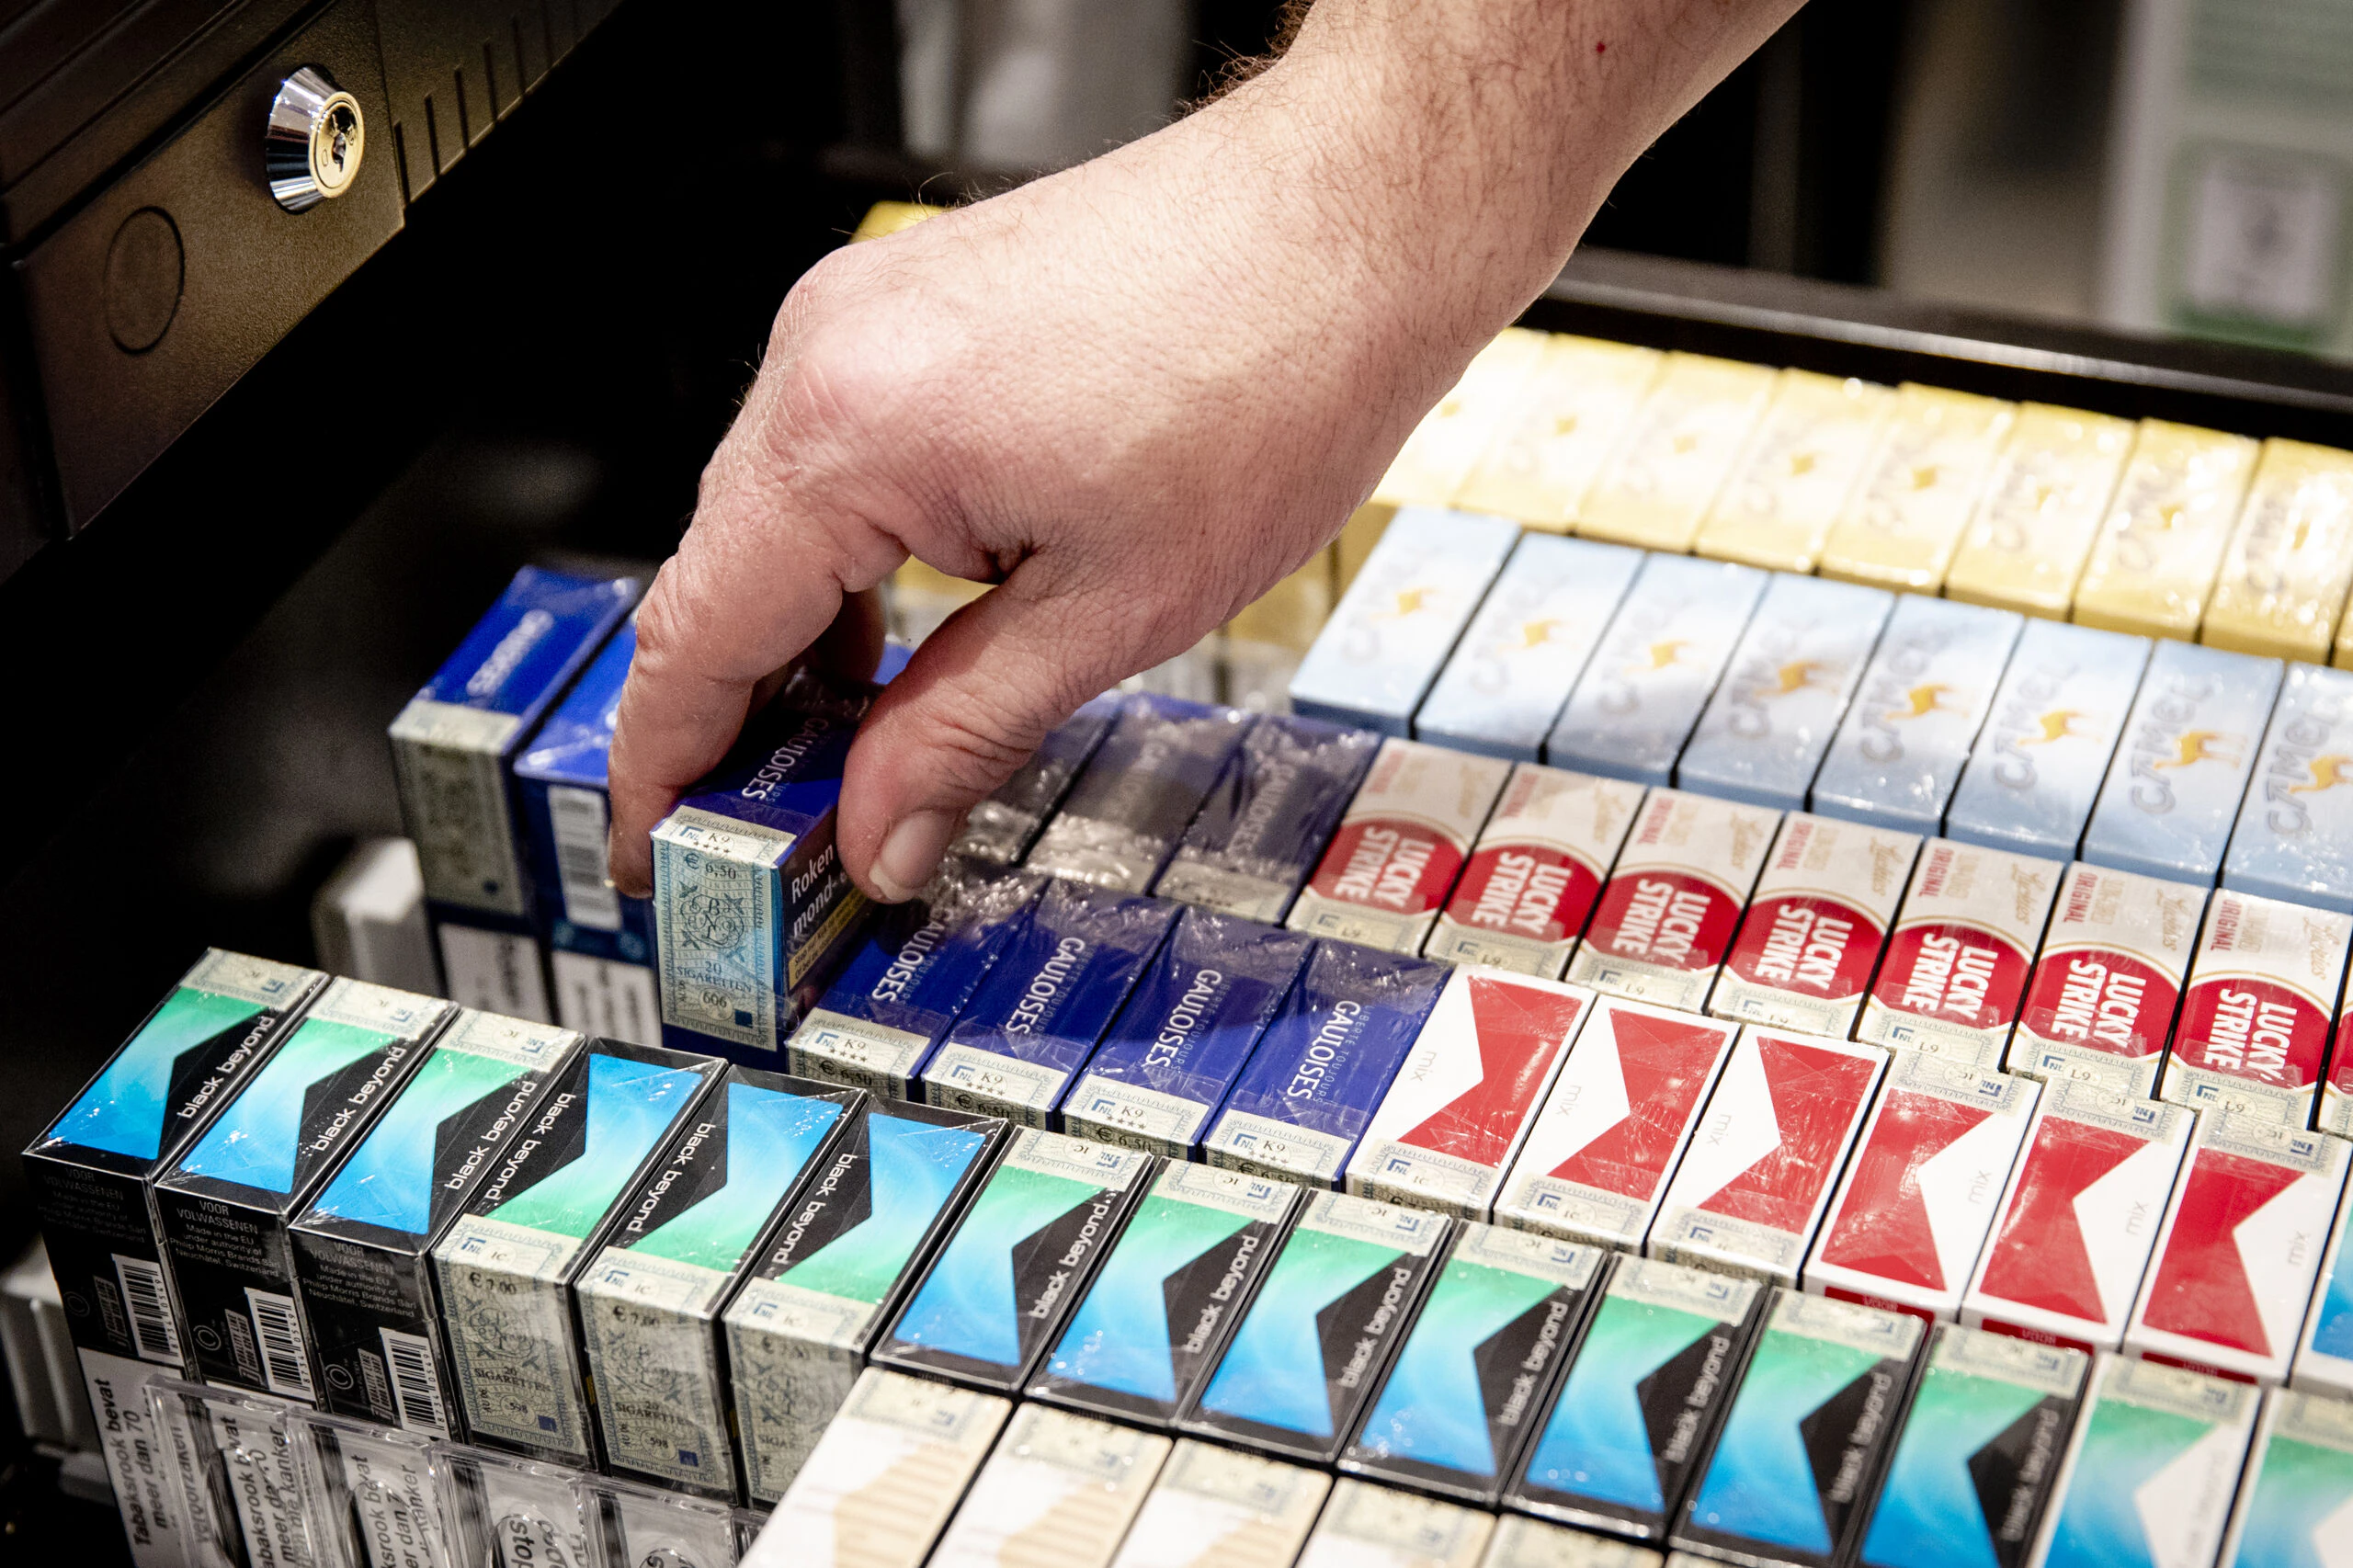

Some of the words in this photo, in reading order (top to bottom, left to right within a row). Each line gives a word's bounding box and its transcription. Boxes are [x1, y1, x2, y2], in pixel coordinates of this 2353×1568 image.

[742, 718, 829, 800] GAULOISES
[708, 833, 730, 843] K9
[1776, 821, 1813, 870] ORIGINAL
[684, 852, 699, 870] €
[705, 862, 736, 880] 6,50
[791, 844, 834, 904] Roken
[1334, 826, 1399, 898] STRIKE
[1373, 838, 1436, 908] LUCKY
[1918, 846, 1954, 898] ORIGINAL
[793, 874, 837, 938] mond-
[1472, 851, 1535, 926] STRIKE
[1513, 863, 1572, 934] LUCKY
[2063, 872, 2098, 923] ORIGINAL
[1611, 879, 1674, 954] STRIKE
[1654, 891, 1711, 964] LUCKY
[2211, 899, 2243, 951] ORIGINAL
[871, 908, 953, 1002] GAULOISES
[1755, 903, 1815, 982] STRIKE
[1796, 915, 1853, 990] LUCKY
[676, 966, 752, 993] SIGARETTEN
[705, 961, 722, 974] 20
[1006, 937, 1085, 1034] GAULOISES
[1903, 933, 1960, 1011] STRIKE
[1944, 945, 1998, 1019] LUCKY
[702, 990, 727, 1008] 606
[1145, 969, 1222, 1067] GAULOISES
[2051, 959, 2108, 1040] STRIKE
[2093, 972, 2146, 1048] LUCKY
[844, 1039, 866, 1050] K9
[1287, 1001, 1360, 1099] GAULOISES
[1918, 1043, 1939, 1053] L9
[2204, 988, 2256, 1070] STRIKE
[2246, 1001, 2297, 1081] LUCKY
[176, 1075, 224, 1119] black
[216, 1016, 276, 1074] beyond
[820, 1060, 835, 1075] €
[981, 1073, 1004, 1084] K9
[1313, 1051, 1349, 1102] TOUJOURS
[1410, 1051, 1437, 1082] mix
[2070, 1070, 2091, 1081] L9
[310, 1108, 357, 1151] black
[348, 1046, 407, 1105] beyond
[533, 1093, 576, 1135] black
[956, 1095, 972, 1108] €
[1121, 1106, 1143, 1117] K9
[1555, 1085, 1582, 1116] mix
[2224, 1101, 2245, 1113] L9
[444, 1146, 489, 1189] black
[481, 1081, 537, 1142] beyond
[673, 1121, 716, 1165] black
[1096, 1128, 1113, 1142] €
[1264, 1141, 1286, 1152] K9
[1706, 1113, 1733, 1146] mix
[485, 1140, 541, 1200] beyond
[815, 1153, 858, 1197] black
[1240, 1163, 1256, 1175] €
[1969, 1169, 1992, 1205] mix
[176, 1207, 258, 1235] VOLWASSENEN
[199, 1200, 229, 1215] VOOR
[626, 1170, 682, 1233] beyond
[2126, 1200, 2149, 1236] mix
[334, 1242, 364, 1257] VOOR
[772, 1201, 826, 1266] beyond
[2289, 1231, 2312, 1267] mix
[310, 1249, 394, 1276] VOLWASSENEN
[316, 1273, 340, 1284] under
[320, 1264, 346, 1277] Made
[358, 1272, 374, 1282] the
[375, 1277, 390, 1287] EU
[469, 1272, 483, 1288] €
[1028, 1270, 1071, 1319] black
[1059, 1203, 1108, 1267] beyond
[302, 1278, 327, 1292] Philip
[329, 1283, 359, 1298] Morris
[362, 1290, 395, 1305] Brands
[359, 1299, 415, 1318] Switzerland
[1181, 1302, 1223, 1354] black
[1210, 1234, 1260, 1301] beyond
[288, 1313, 301, 1343] 0549
[1336, 1337, 1377, 1388] black
[1363, 1267, 1412, 1335] beyond
[423, 1353, 435, 1382] 0549
[1496, 1373, 1539, 1426] black
[1521, 1301, 1568, 1371] beyond
[95, 1379, 120, 1432] bevat
[123, 1411, 139, 1431] 70
[134, 1440, 154, 1475] dan
[650, 1437, 669, 1449] 598
[108, 1437, 152, 1546] Tabaksrook
[145, 1482, 168, 1529] meer
[237, 1471, 276, 1568] abaksrook
